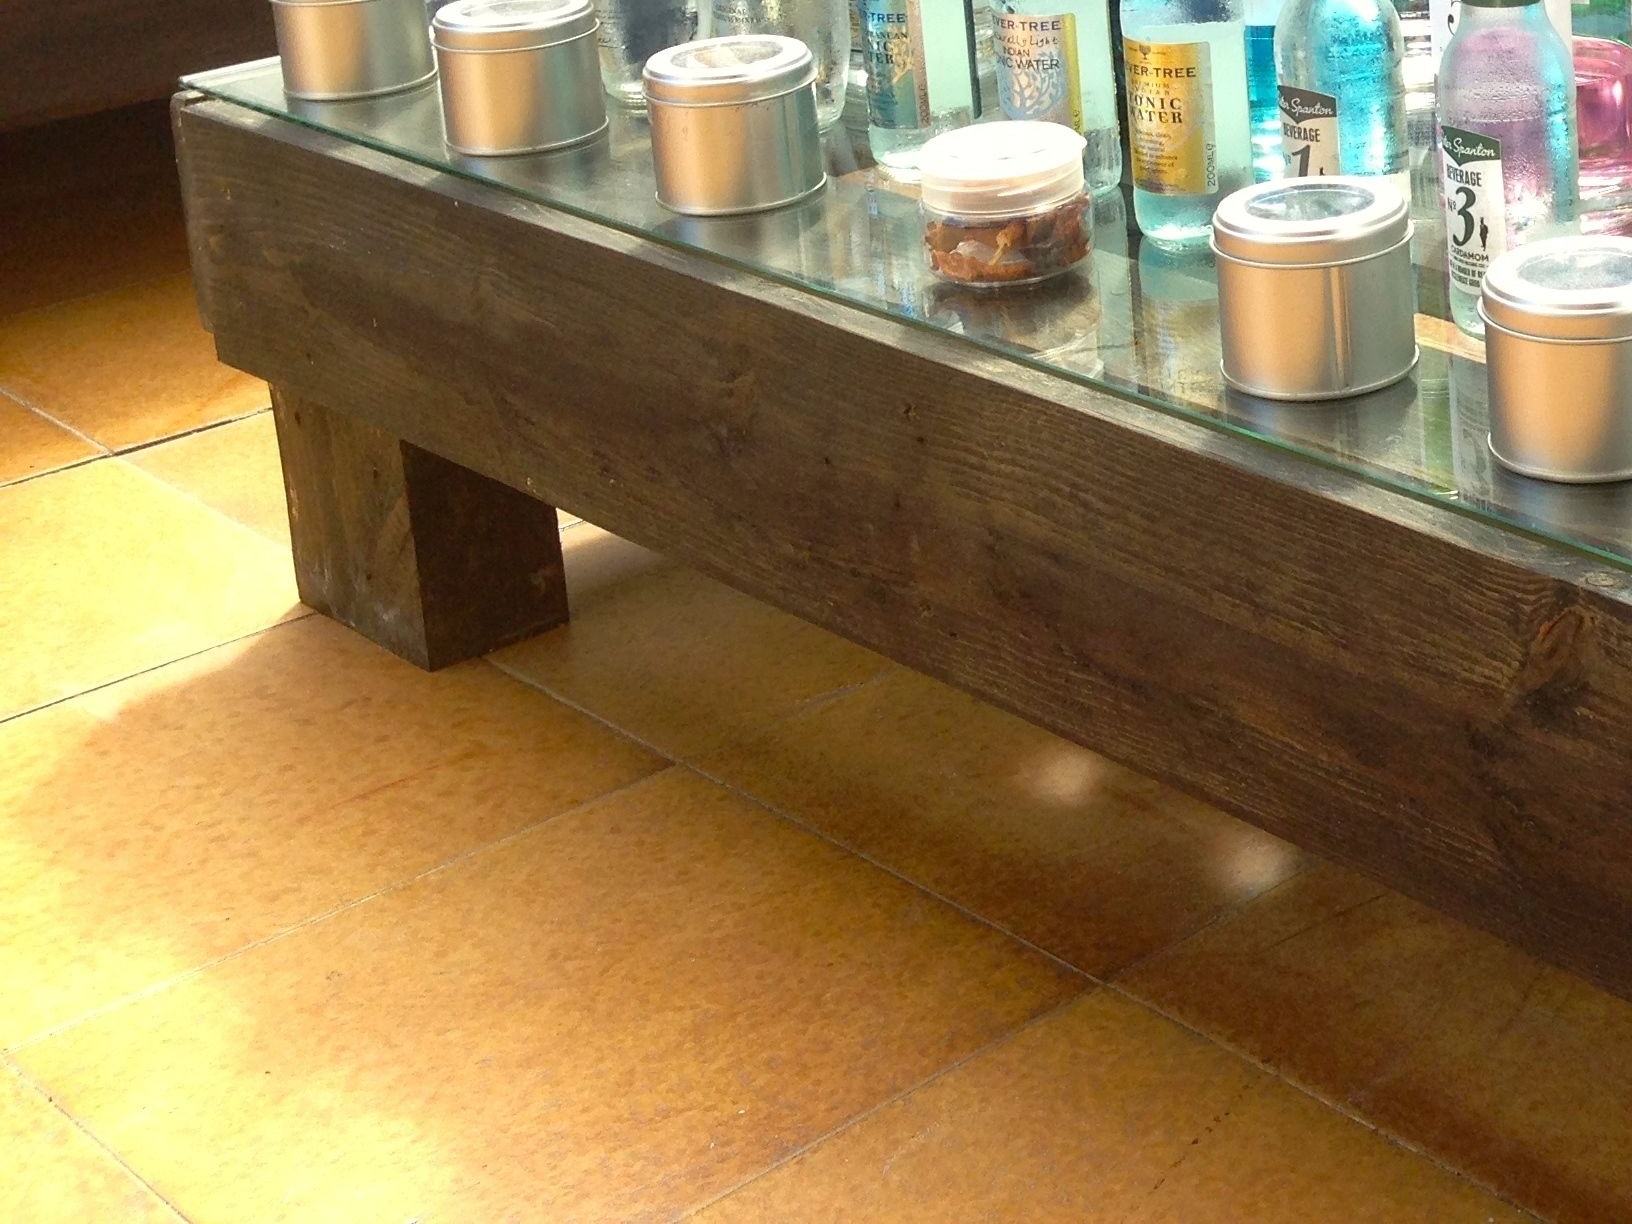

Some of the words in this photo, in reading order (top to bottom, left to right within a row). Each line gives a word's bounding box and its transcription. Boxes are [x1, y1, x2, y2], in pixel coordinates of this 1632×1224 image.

[1015, 58, 1061, 72] WATER
[1289, 97, 1333, 119] Spanton
[1453, 137, 1496, 158] Spanton
[1452, 186, 1476, 247] 3
